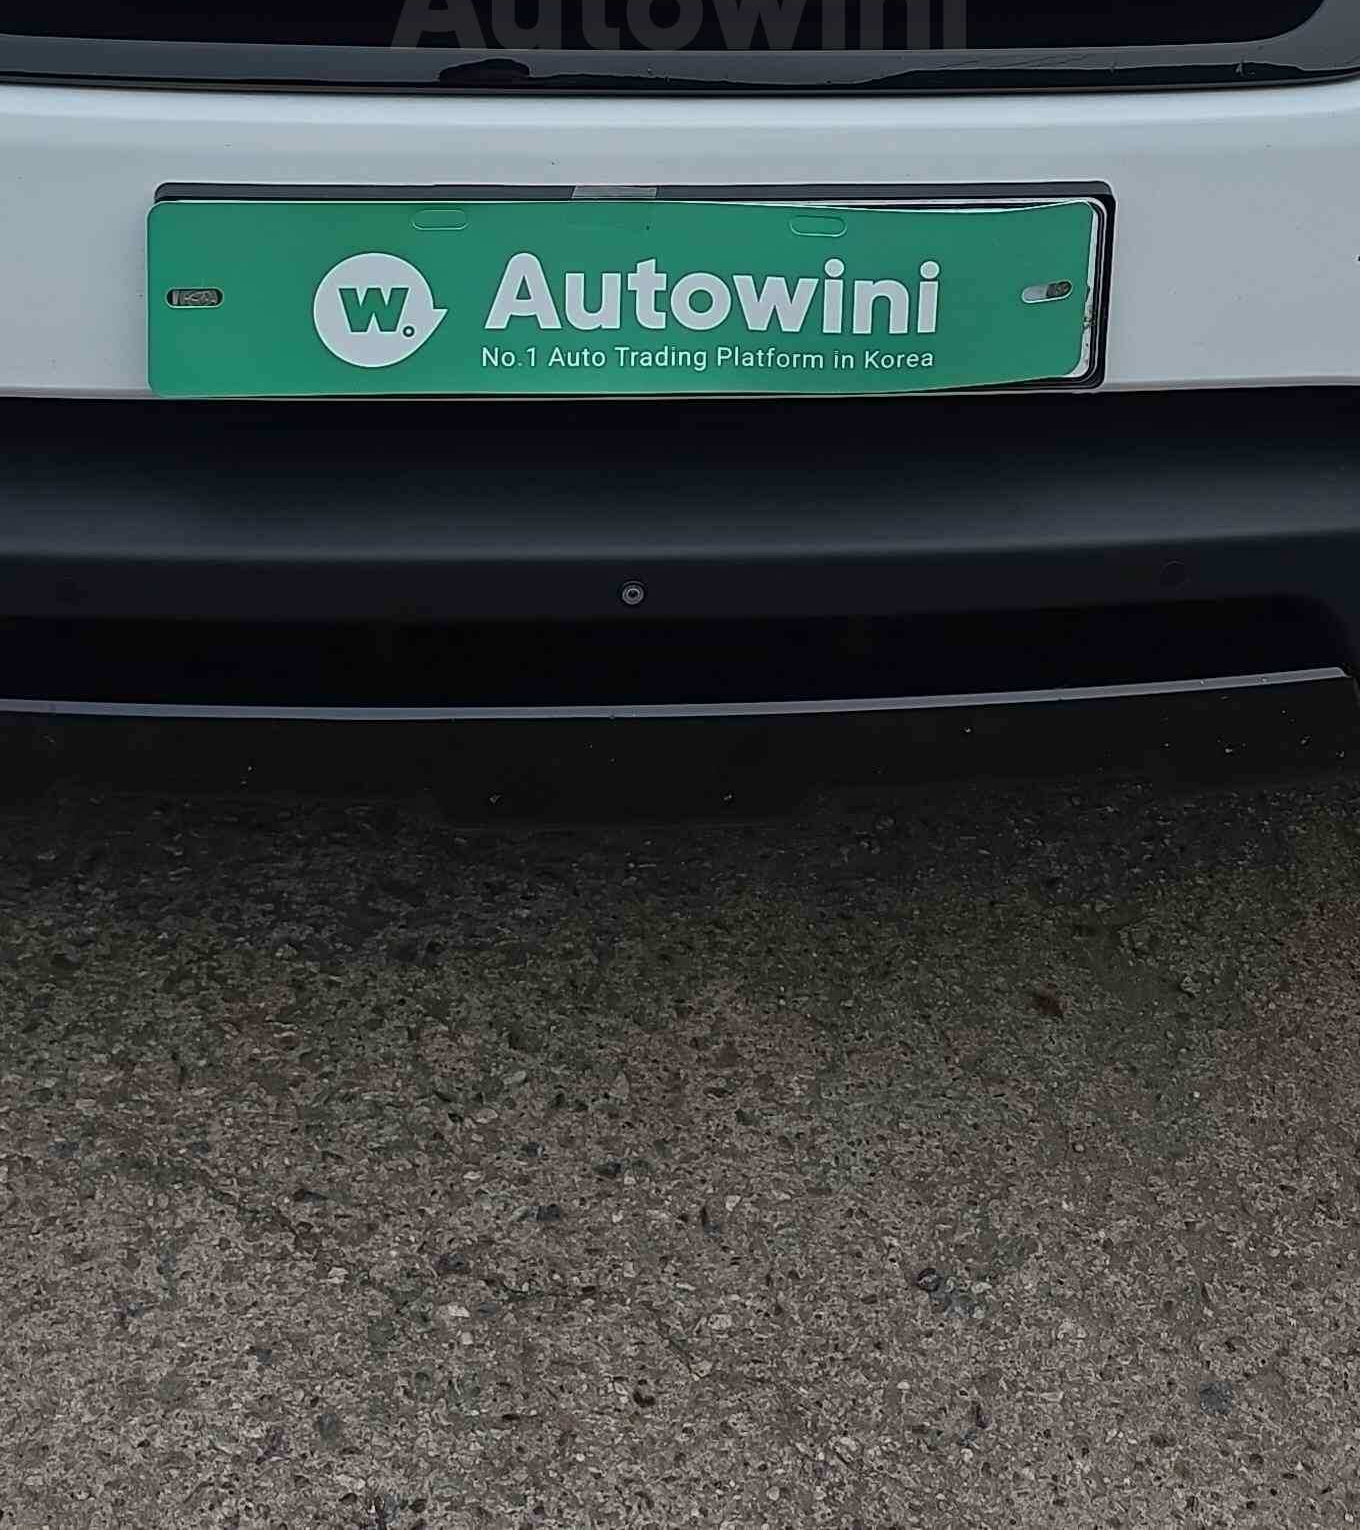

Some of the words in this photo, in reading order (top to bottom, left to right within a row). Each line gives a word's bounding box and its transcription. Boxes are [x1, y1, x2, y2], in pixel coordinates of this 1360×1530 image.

[483, 252, 941, 335] Autowini
[547, 346, 607, 368] Auto
[613, 345, 708, 372] Trading
[716, 345, 825, 369] Platform
[833, 350, 855, 369] in
[863, 350, 934, 369] Korea
